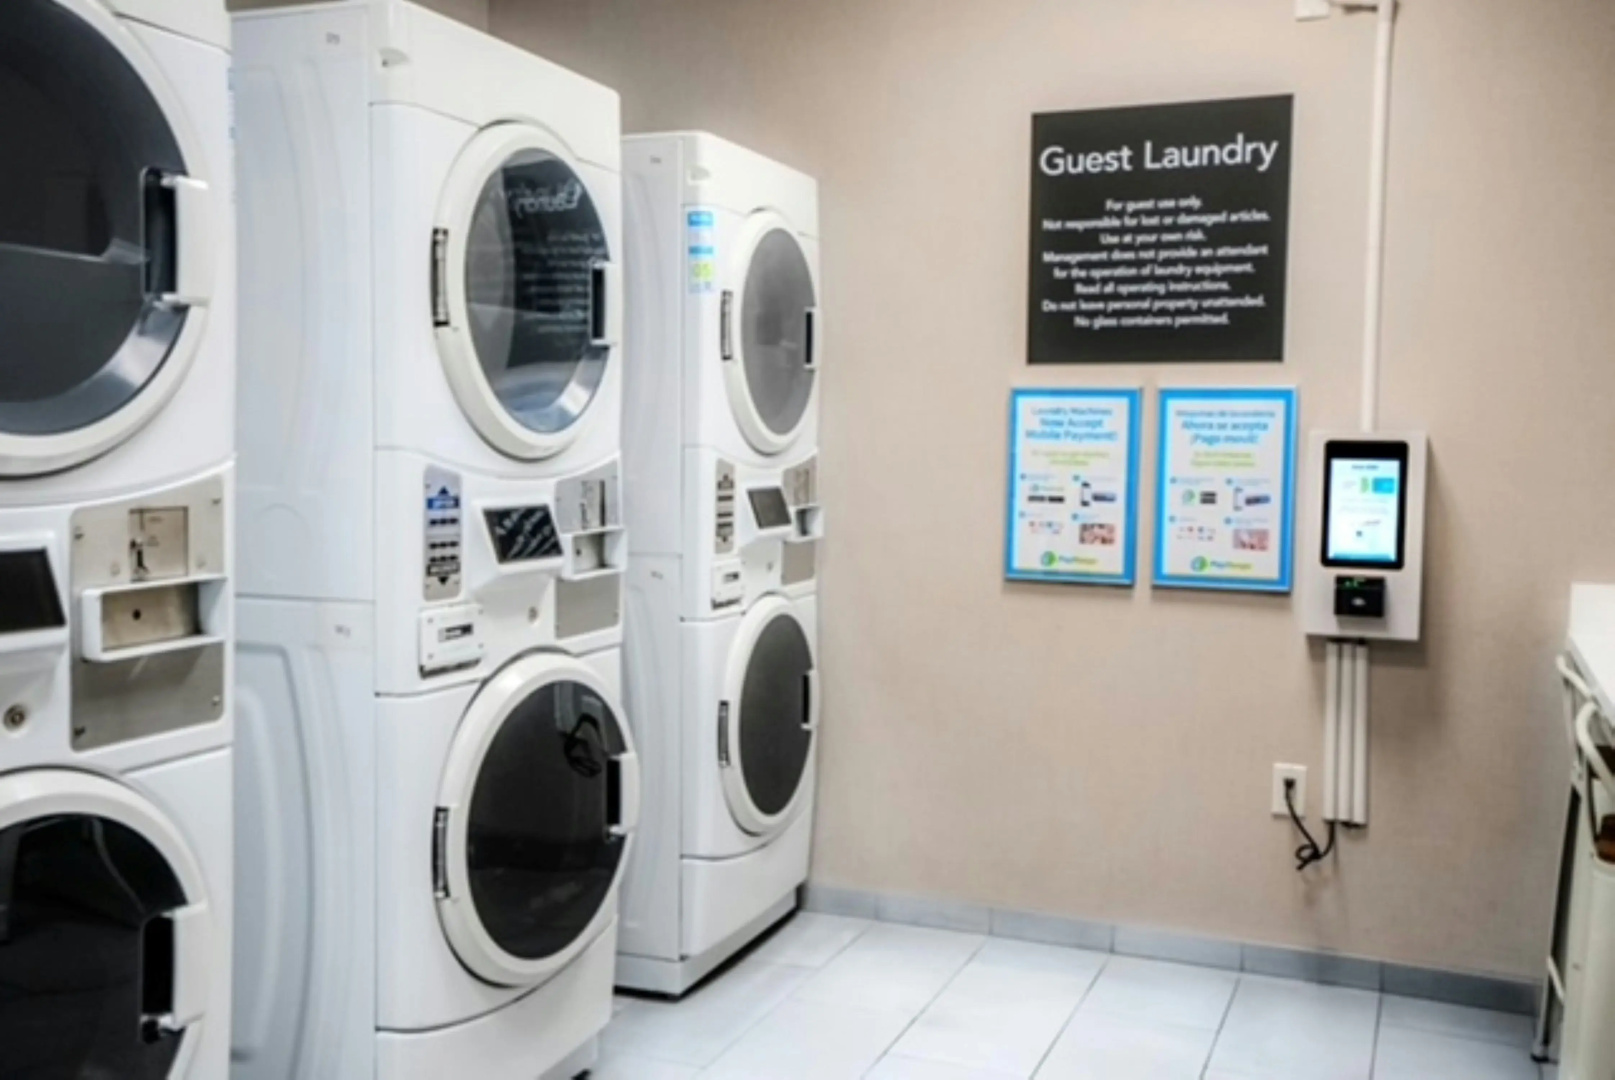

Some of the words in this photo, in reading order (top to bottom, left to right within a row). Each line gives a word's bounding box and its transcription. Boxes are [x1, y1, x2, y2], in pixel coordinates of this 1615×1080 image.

[1039, 145, 1133, 176] Guest
[1143, 132, 1278, 172] Laundry
[1105, 199, 1122, 211] For
[1126, 199, 1155, 214] guest
[1157, 199, 1175, 209] use
[1042, 219, 1062, 231] Not
[1065, 216, 1121, 232] responsible
[1123, 215, 1138, 226] for
[1140, 214, 1160, 226] lost
[1162, 216, 1173, 226] or
[1177, 212, 1228, 227] damaged
[1229, 208, 1271, 222] articles.
[1099, 234, 1120, 245] Use
[1121, 233, 1133, 244] at
[1134, 233, 1158, 247] your
[1161, 232, 1183, 242] own
[1185, 229, 1207, 241] risk.
[1042, 252, 1108, 265] Management
[1111, 249, 1135, 260] does
[1138, 249, 1156, 260] not
[1157, 246, 1198, 262] provide
[1201, 248, 1214, 258] an
[1216, 243, 1269, 257] attendant
[1053, 266, 1067, 279] for
[1071, 266, 1087, 279] the
[1089, 265, 1138, 280] operation
[1139, 263, 1152, 276] of
[1154, 263, 1194, 279] laundry
[1195, 262, 1256, 278] equipment.
[1074, 282, 1101, 295] Read
[1103, 281, 1115, 294] all
[1116, 280, 1166, 296] operating
[1167, 279, 1231, 293] instructions.
[1041, 299, 1057, 312] Do
[1060, 301, 1077, 311] not
[1079, 298, 1105, 311] leave
[1107, 297, 1151, 314] personal
[1152, 298, 1199, 313] property
[1202, 294, 1266, 308] unattended.
[1073, 315, 1090, 328] No
[1092, 314, 1117, 330] glass
[1119, 314, 1173, 328] containers
[1174, 312, 1230, 330] permitted.
